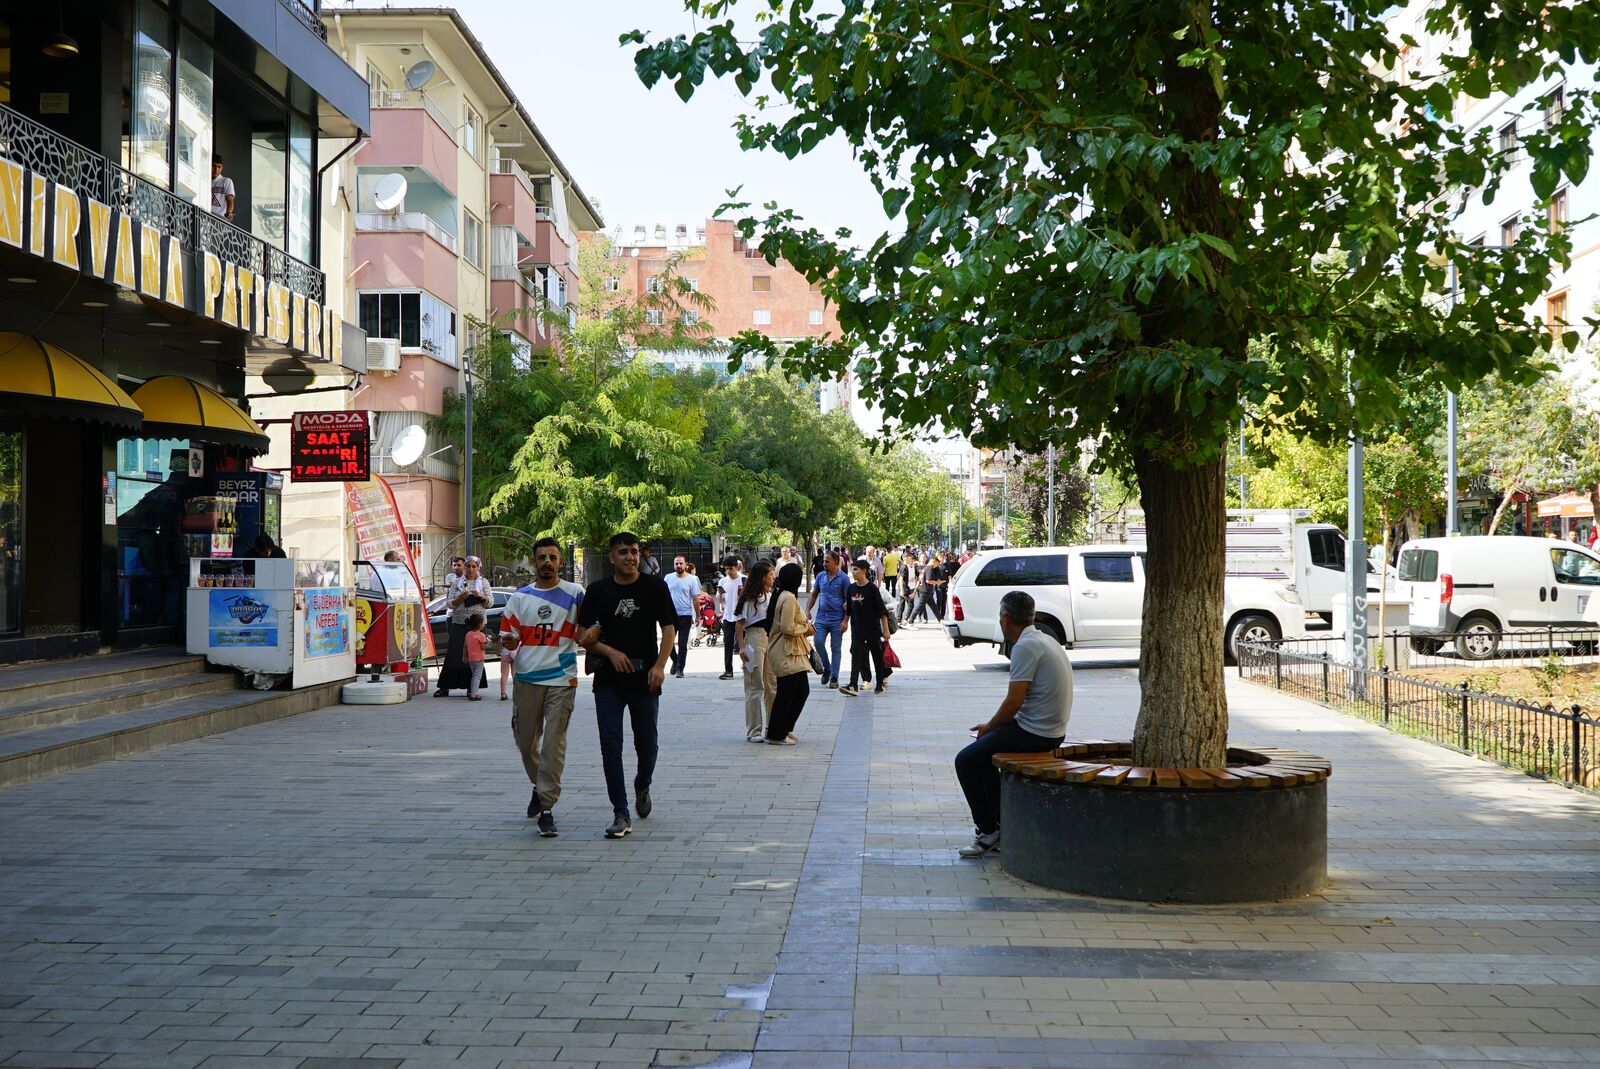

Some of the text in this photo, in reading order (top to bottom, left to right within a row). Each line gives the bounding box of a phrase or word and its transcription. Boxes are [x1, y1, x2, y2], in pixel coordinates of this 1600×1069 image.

[302, 413, 364, 425] MODA
[306, 432, 351, 445] SAAT
[218, 480, 256, 490] BEYAZ
